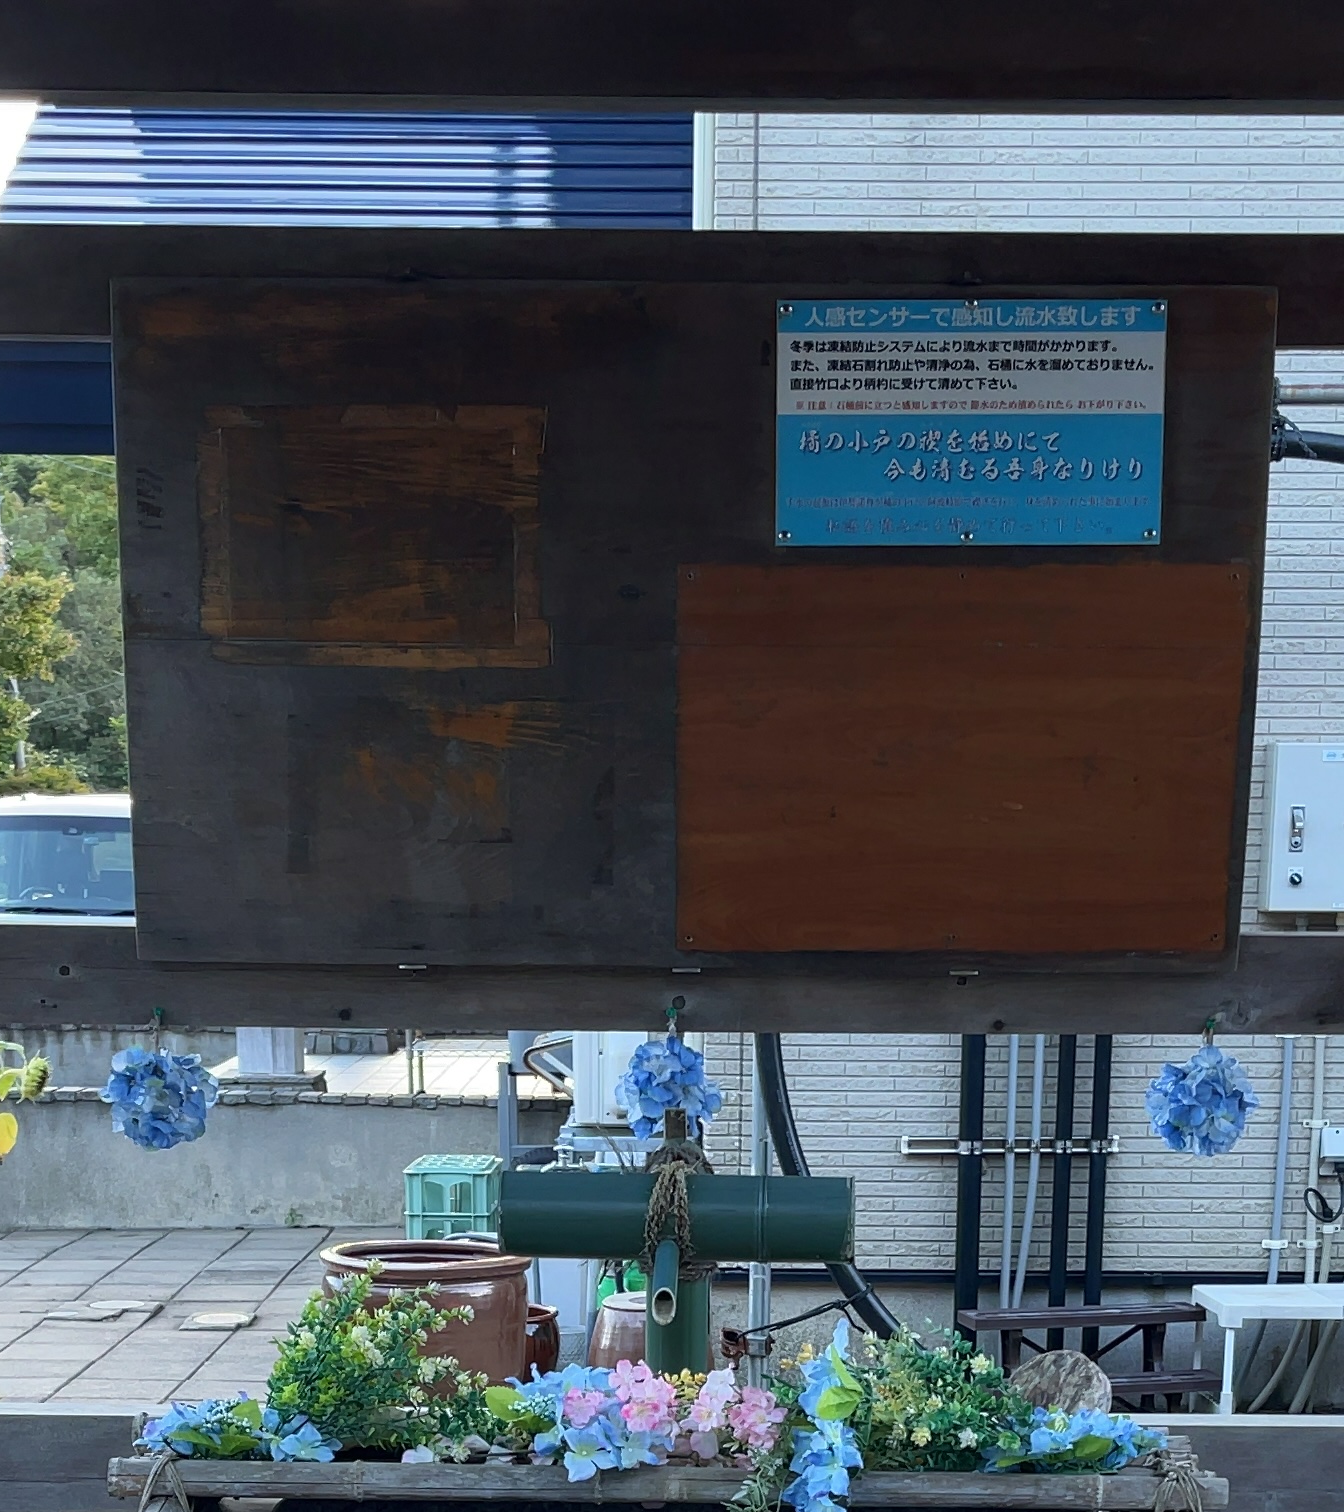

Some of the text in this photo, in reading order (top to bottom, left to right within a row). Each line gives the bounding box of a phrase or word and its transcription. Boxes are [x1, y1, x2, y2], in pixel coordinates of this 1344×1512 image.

[804, 306, 1140, 328] 人感センサーで感知し流水致します
